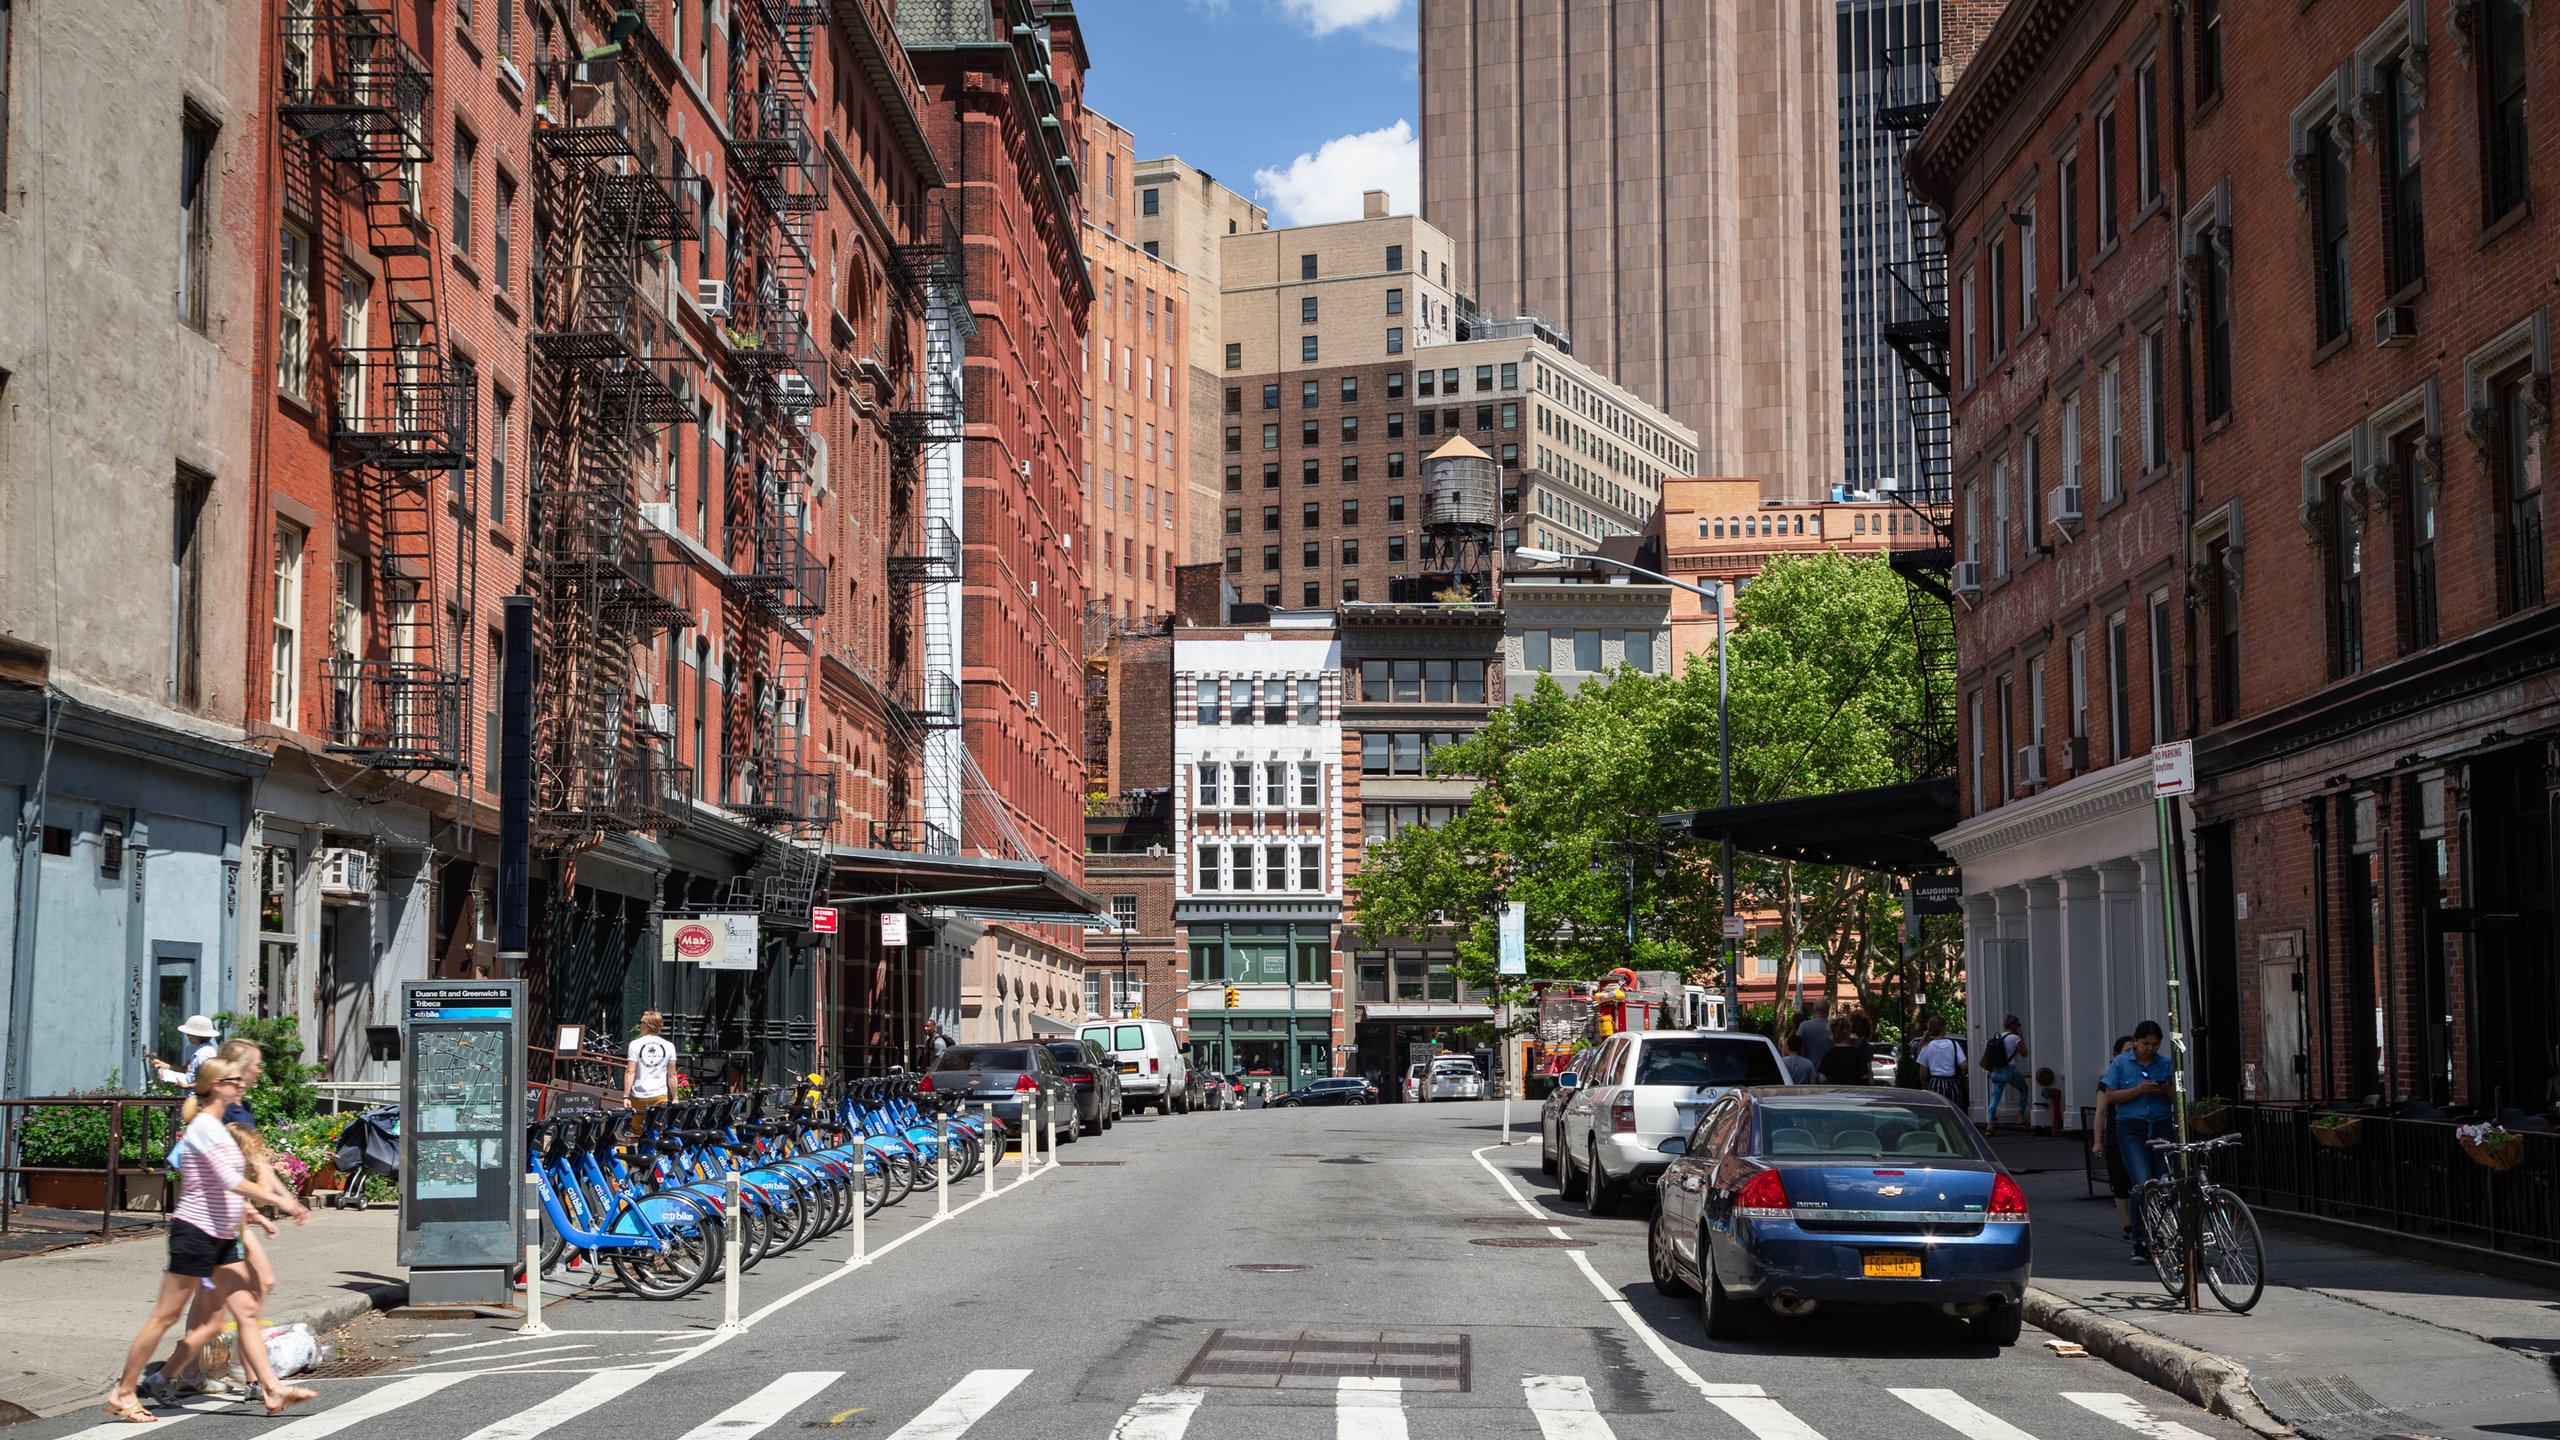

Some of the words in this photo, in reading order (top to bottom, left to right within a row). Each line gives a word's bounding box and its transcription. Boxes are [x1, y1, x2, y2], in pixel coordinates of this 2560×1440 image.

[2155, 752, 2161, 760] NO
[2162, 748, 2182, 759] PARKING
[2156, 762, 2174, 773] Anytime
[1916, 887, 1959, 895] LAUGHING
[681, 936, 707, 945] Max
[762, 1182, 773, 1190] citi
[539, 1184, 550, 1202] bike
[567, 1187, 578, 1200] citi
[594, 1184, 604, 1196] citi
[600, 1194, 611, 1212] bike
[572, 1197, 583, 1215] bike
[662, 1211, 676, 1221] citi
[676, 1212, 694, 1221] bike
[1895, 1257, 1916, 1271] 1475
